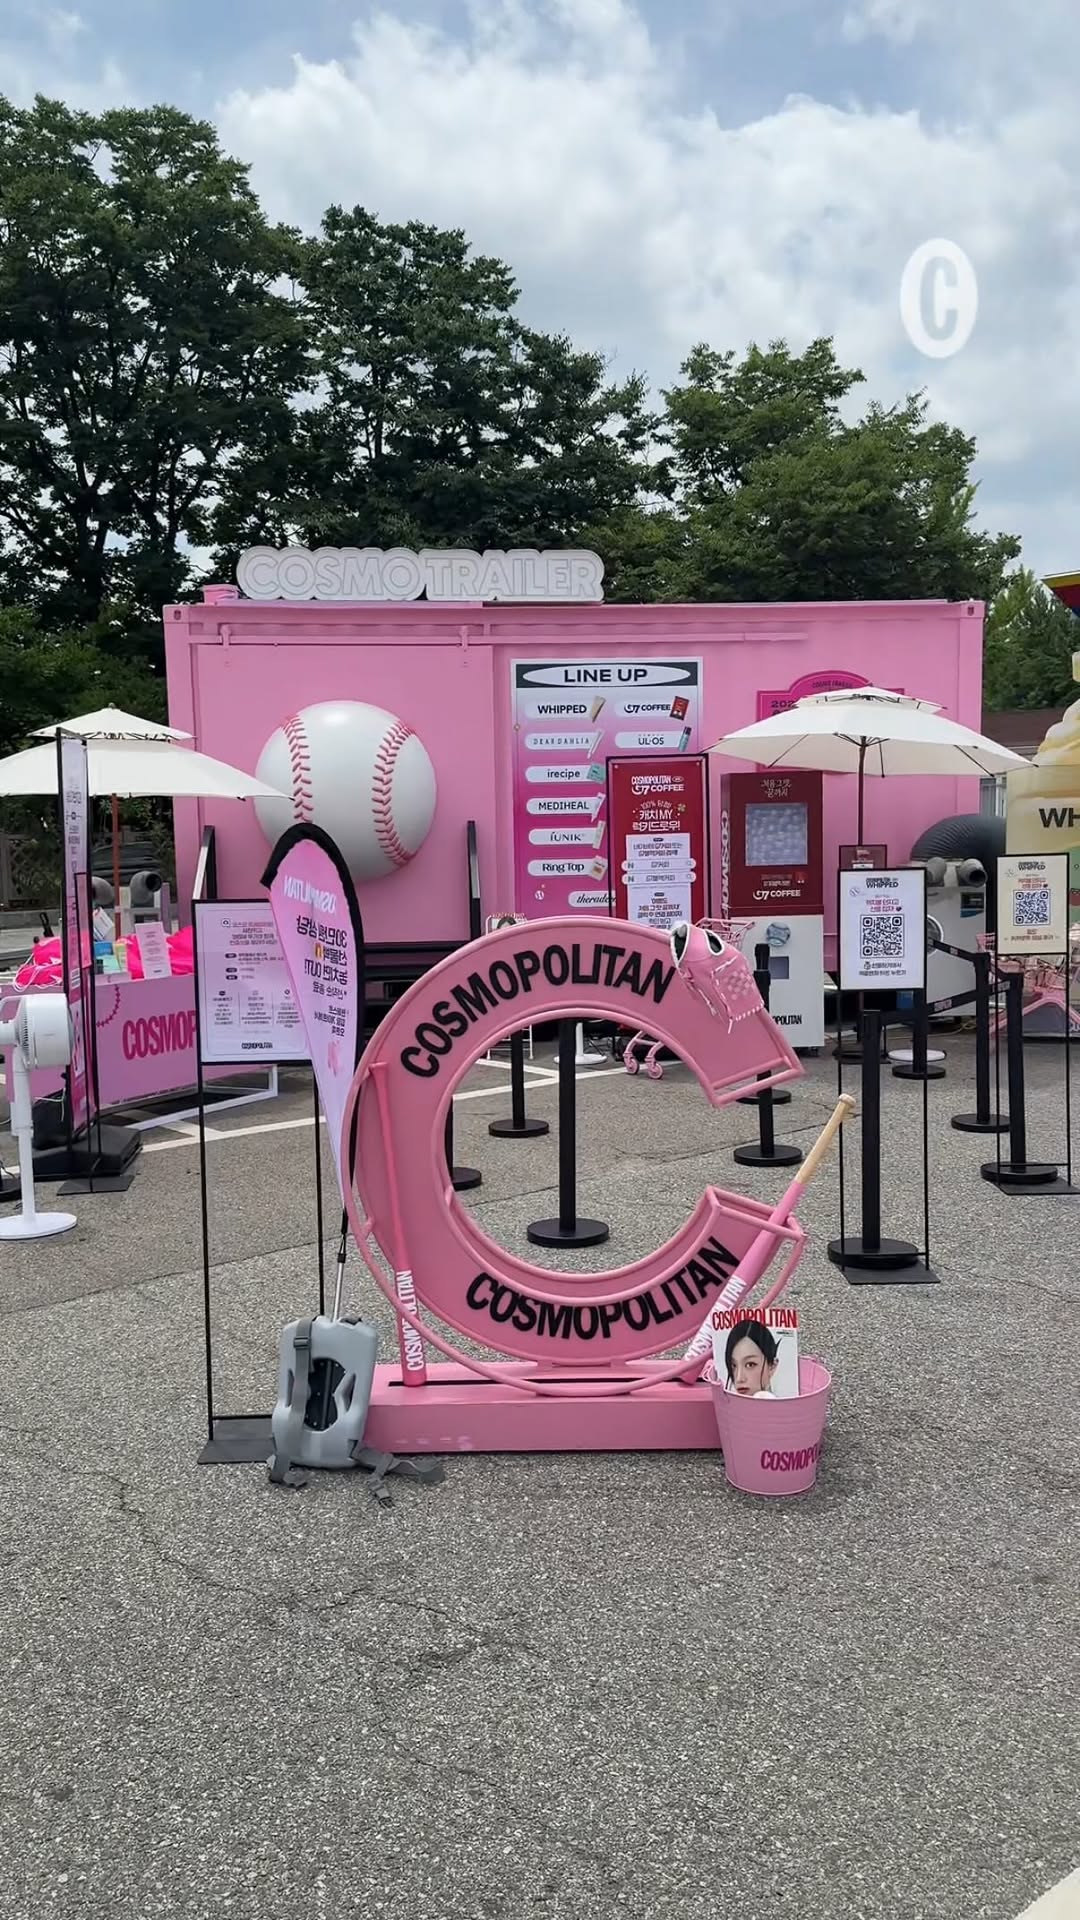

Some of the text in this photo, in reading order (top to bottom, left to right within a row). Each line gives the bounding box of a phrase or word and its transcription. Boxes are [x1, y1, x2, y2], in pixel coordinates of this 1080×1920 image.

[564, 668, 648, 683] LINE UP
[537, 704, 587, 714] WHIPPED
[641, 703, 671, 712] COFFEE
[557, 737, 590, 745] DAHLIA
[547, 768, 580, 780] irecipe
[631, 775, 672, 785] COSMOPOLITAN
[651, 784, 684, 792] COFFEE
[538, 801, 589, 811] MEDIHEAL
[659, 809, 673, 820] MY
[542, 863, 566, 873] Ring
[770, 889, 801, 898] COFFEE
[400, 943, 676, 1078] COSMOPOLITAN
[466, 1236, 742, 1340] COSMOPOLITAN
